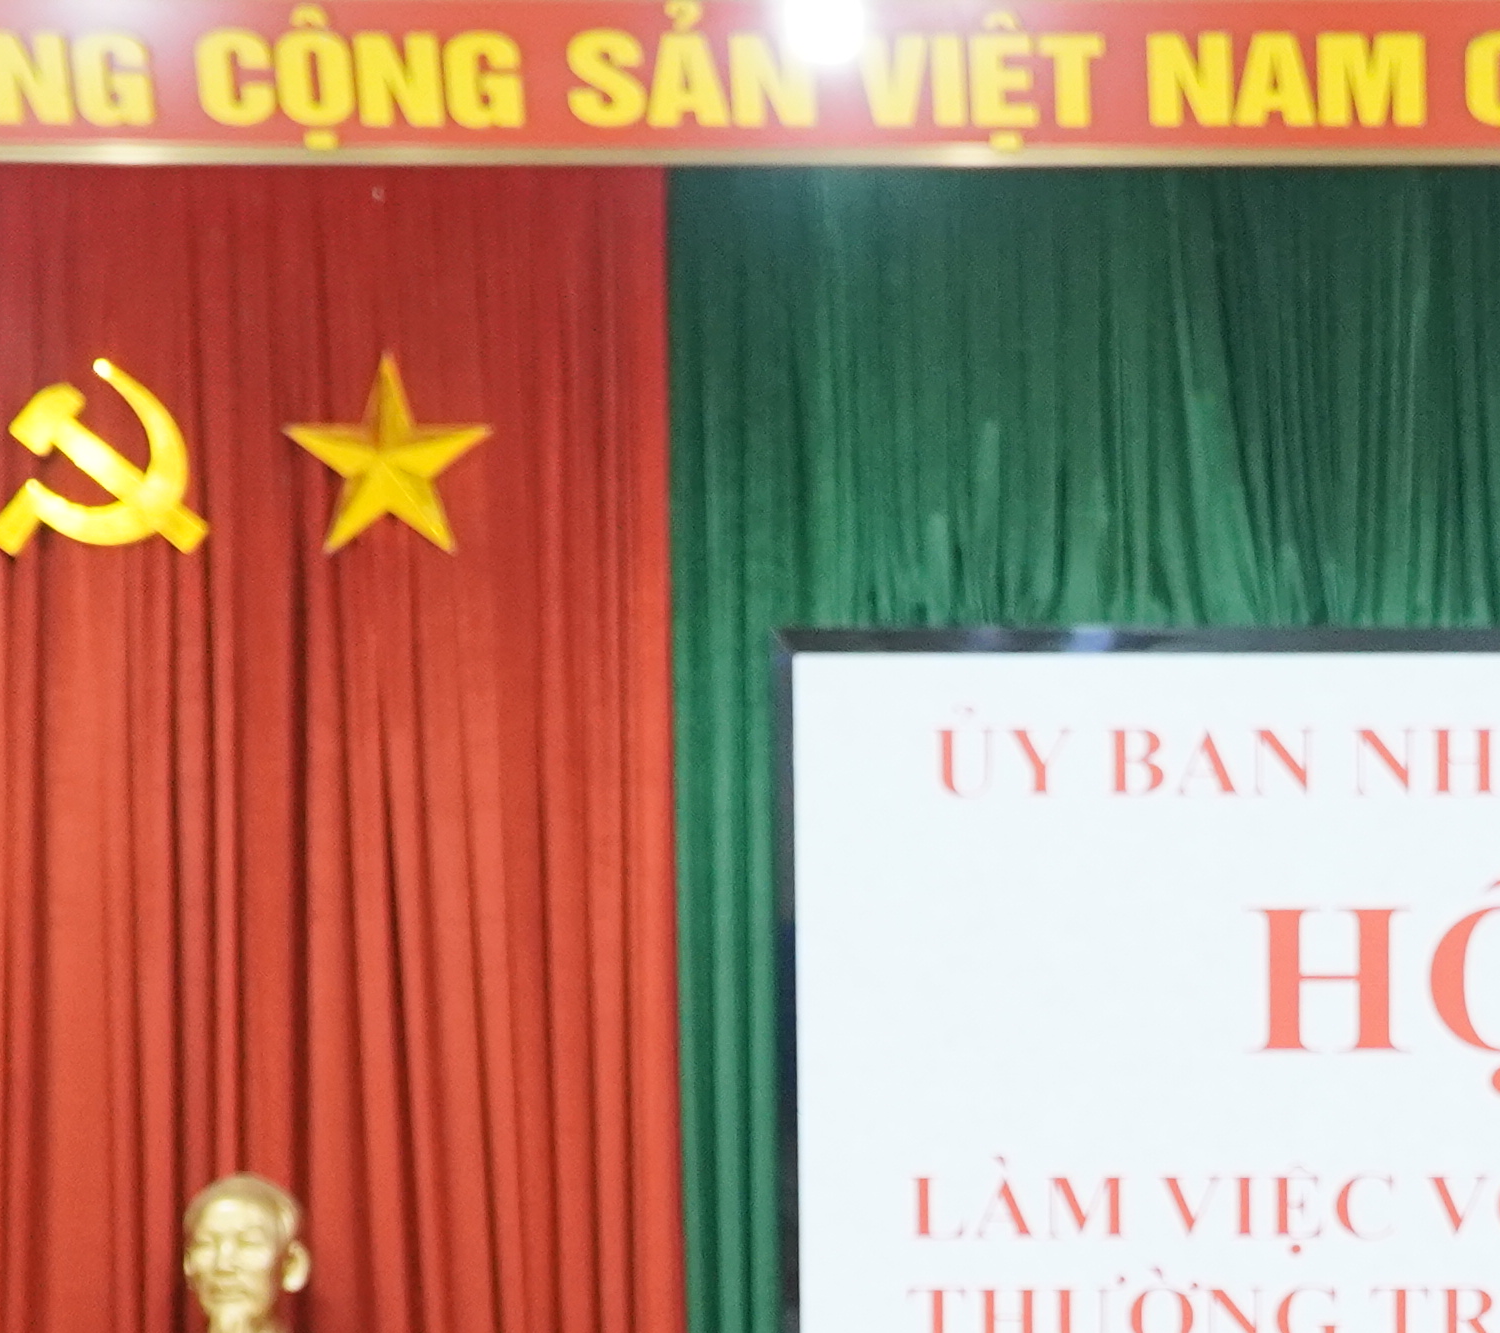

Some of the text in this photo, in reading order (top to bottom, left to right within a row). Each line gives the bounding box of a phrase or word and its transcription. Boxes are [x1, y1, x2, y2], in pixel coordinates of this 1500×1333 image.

[195, 8, 524, 150] CỘNG
[565, 0, 818, 126] SẢN
[856, 11, 1105, 152] VIỆT
[1145, 30, 1427, 128] NAM
[936, 706, 1070, 796] ỦY
[1110, 726, 1312, 796] BAN
[912, 1156, 1124, 1238] LÀM
[1162, 1166, 1395, 1255] VIỆC
